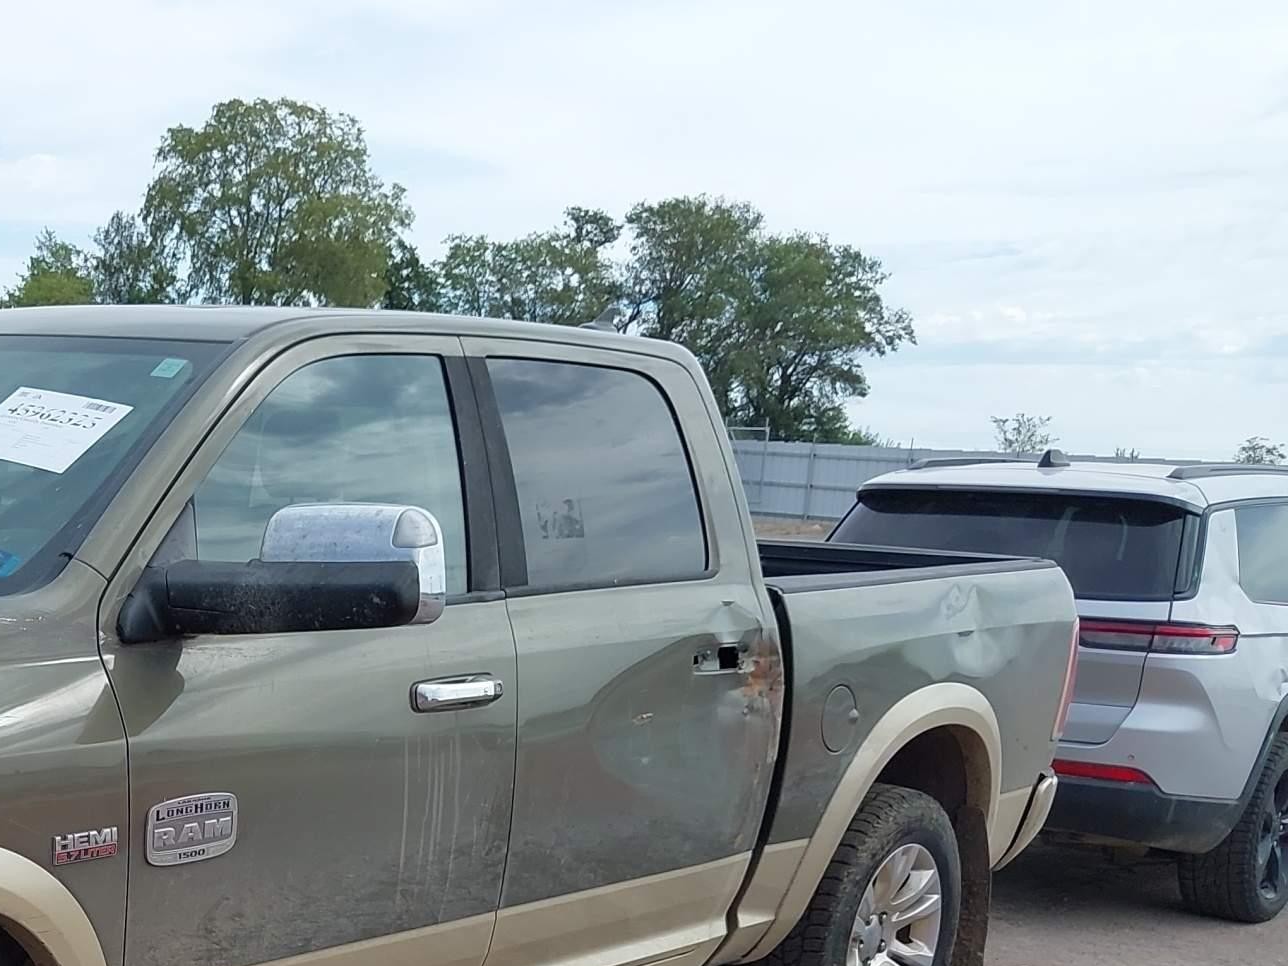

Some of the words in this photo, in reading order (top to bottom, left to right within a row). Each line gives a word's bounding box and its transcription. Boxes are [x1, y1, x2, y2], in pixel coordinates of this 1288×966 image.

[7, 402, 104, 429] 45962325
[55, 827, 118, 852] HEMI
[153, 816, 233, 849] RAM
[178, 849, 206, 860] 1500
